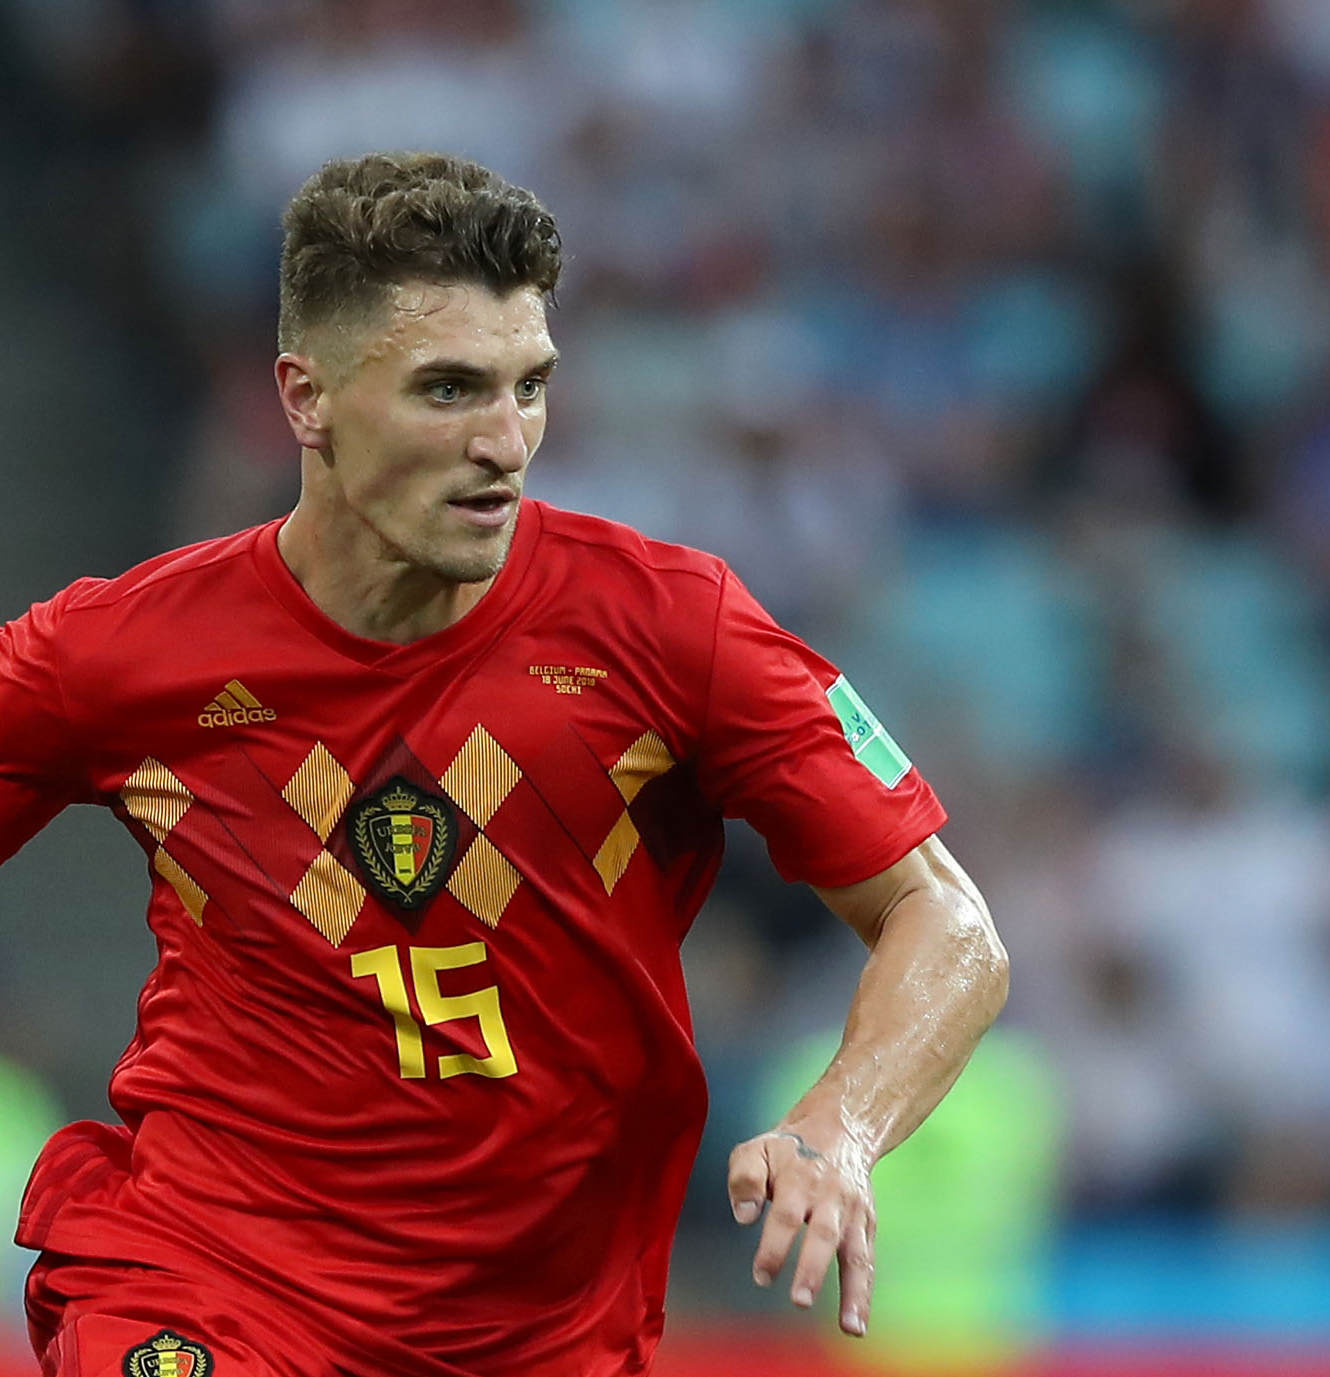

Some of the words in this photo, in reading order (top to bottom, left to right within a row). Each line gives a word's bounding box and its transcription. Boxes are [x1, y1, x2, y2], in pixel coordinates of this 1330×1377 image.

[529, 665, 566, 675] BELGIUM
[574, 667, 608, 679] PANAMA
[553, 675, 574, 685] JUNE
[555, 684, 582, 695] SOCHI
[197, 707, 277, 728] adidas
[350, 941, 518, 1080] 15
